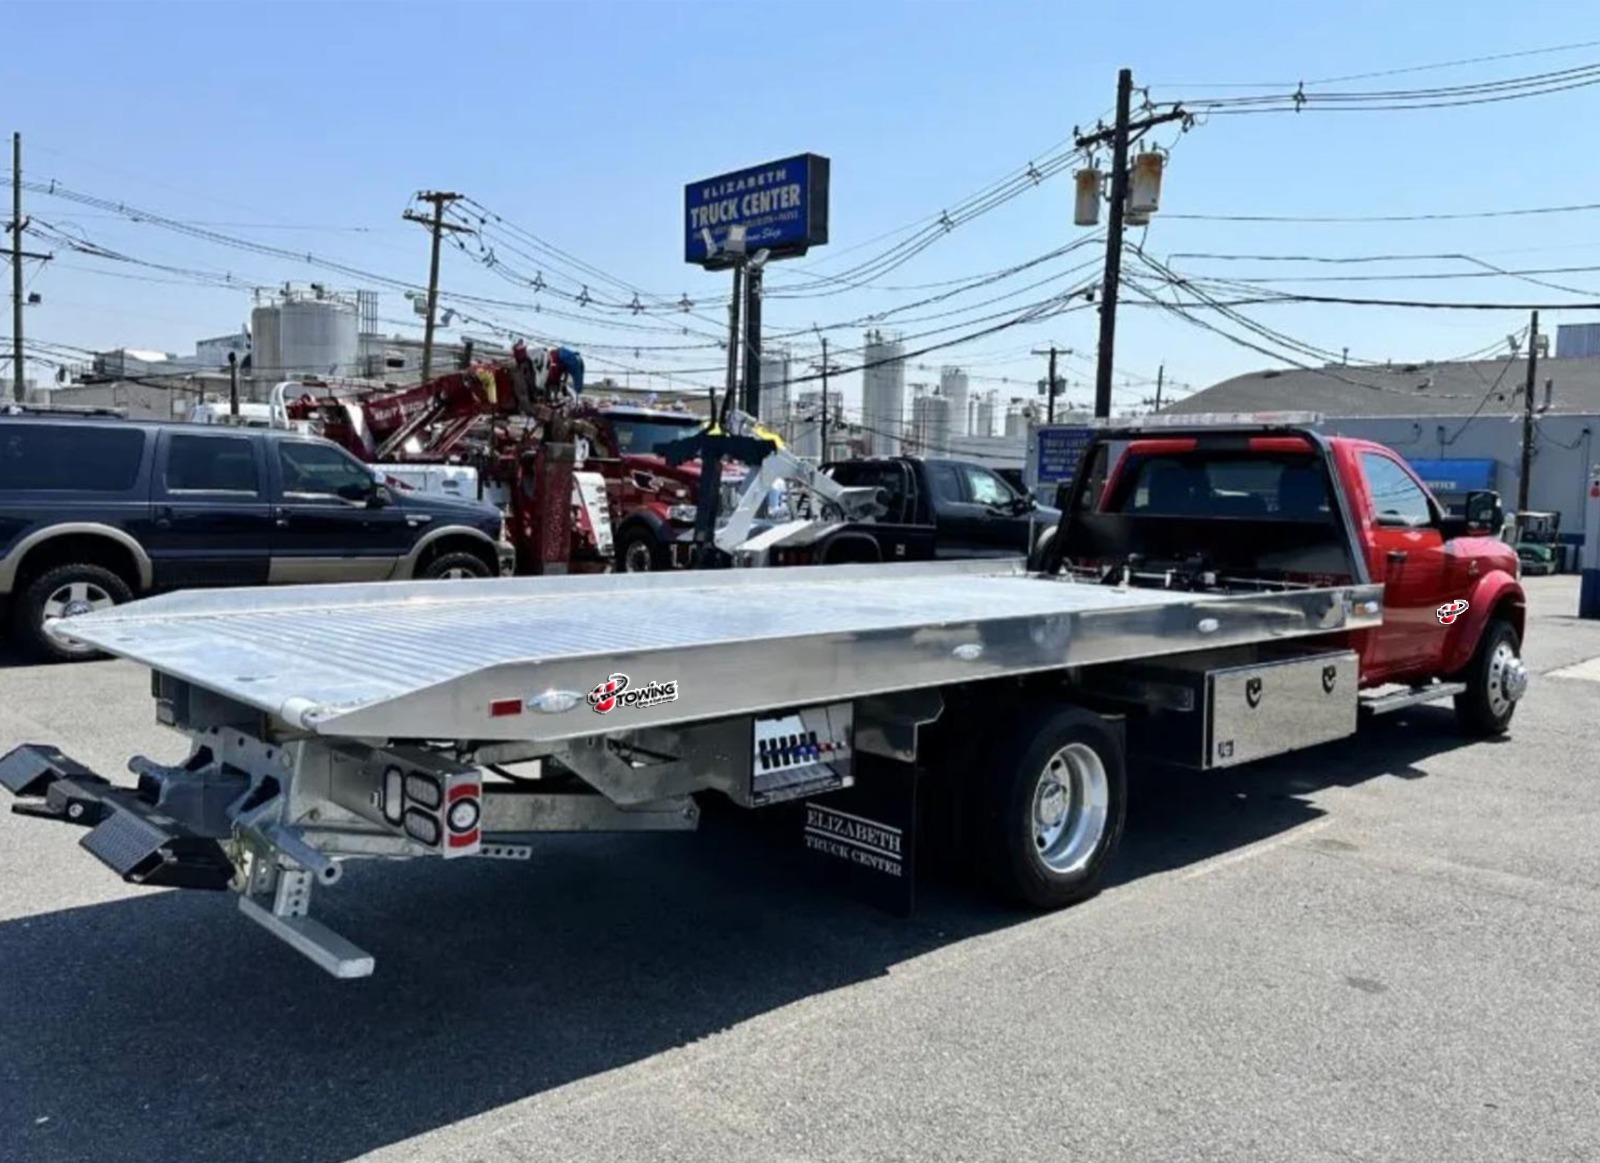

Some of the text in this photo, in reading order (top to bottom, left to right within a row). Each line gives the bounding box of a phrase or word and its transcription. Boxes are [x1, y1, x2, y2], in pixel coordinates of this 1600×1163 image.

[703, 168, 787, 199] ELIZABETH
[690, 184, 800, 229] TRUCK CENTER
[806, 809, 901, 853] ELIZABETH
[804, 834, 902, 877] TRUCK CENTER
